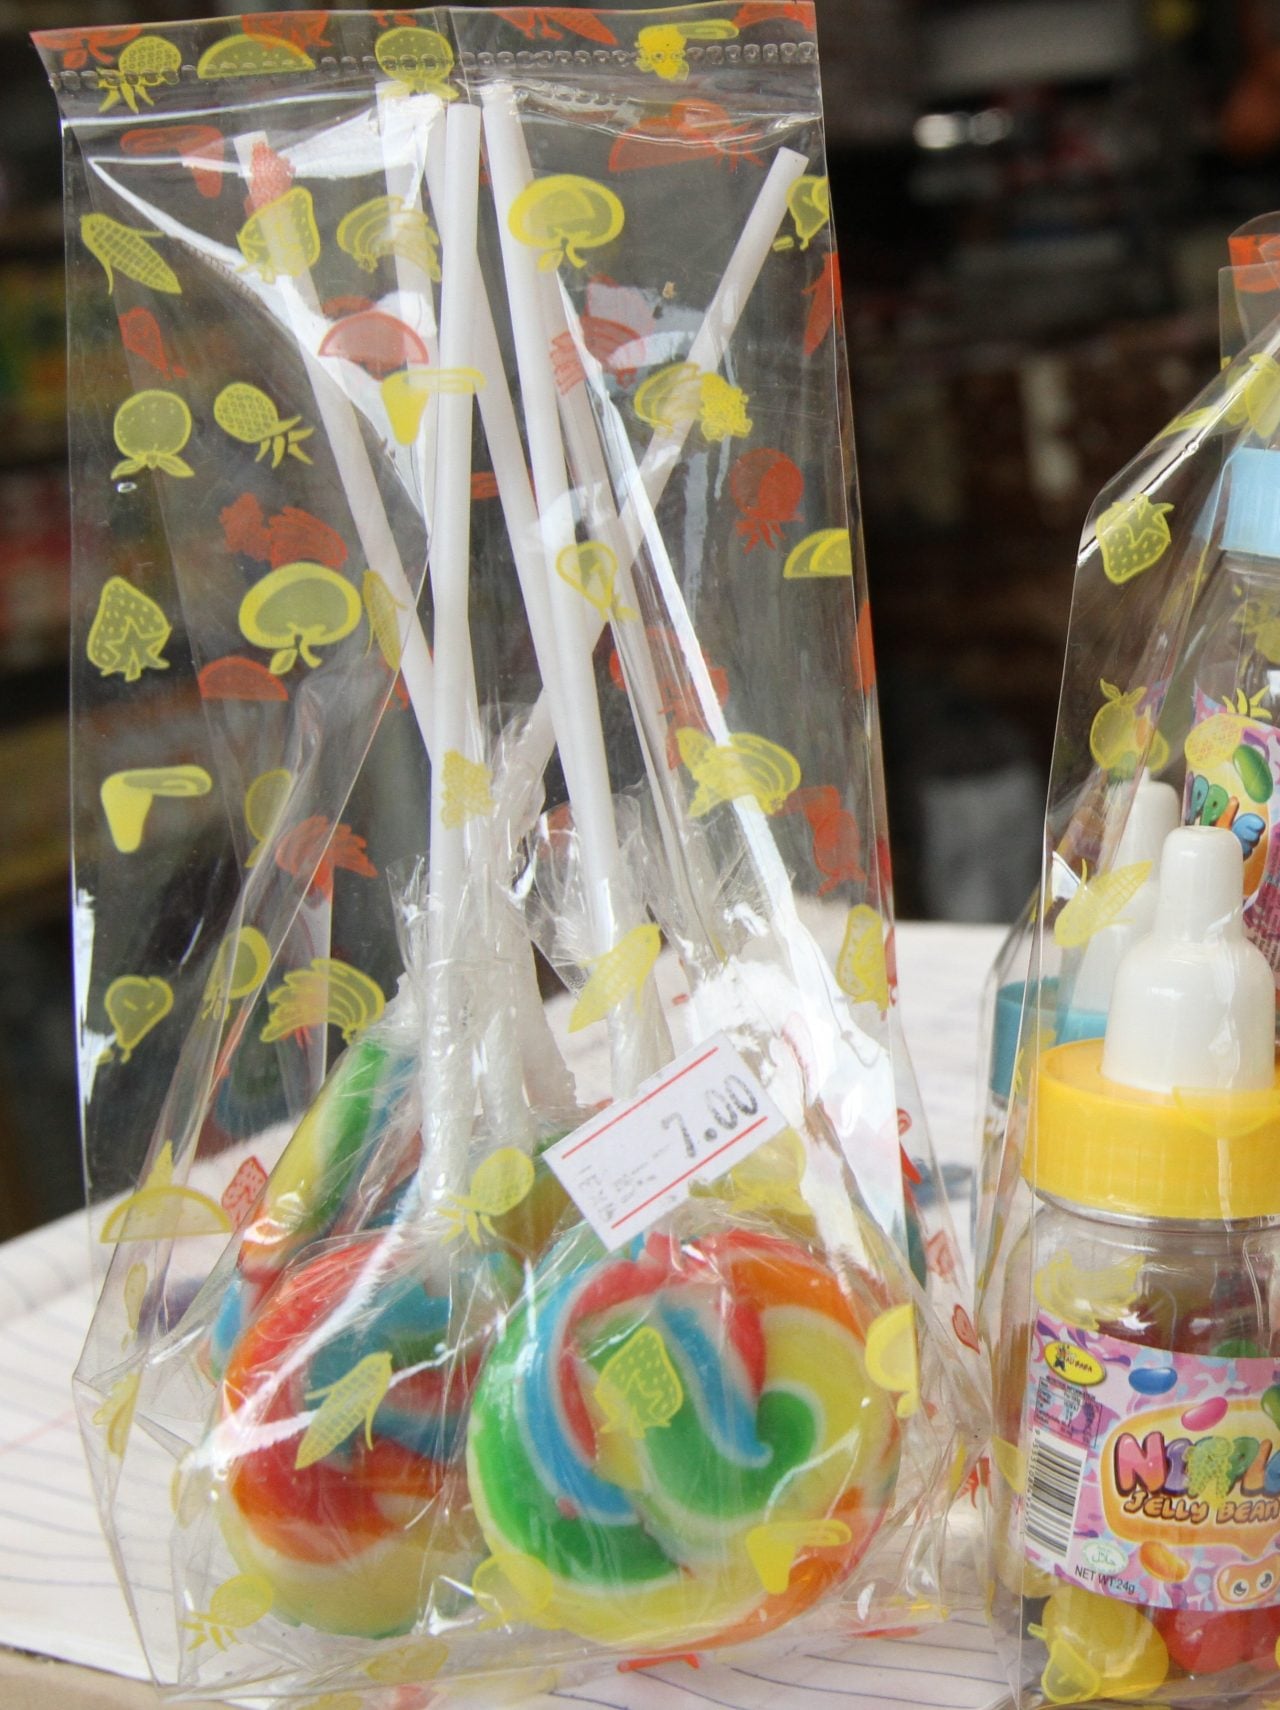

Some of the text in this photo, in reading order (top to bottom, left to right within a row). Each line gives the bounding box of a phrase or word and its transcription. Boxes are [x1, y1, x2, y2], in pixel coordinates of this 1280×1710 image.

[660, 1074, 759, 1158] 7.00
[1123, 1490, 1280, 1525] JELLY BEAN
[1075, 1564, 1096, 1581] NET
